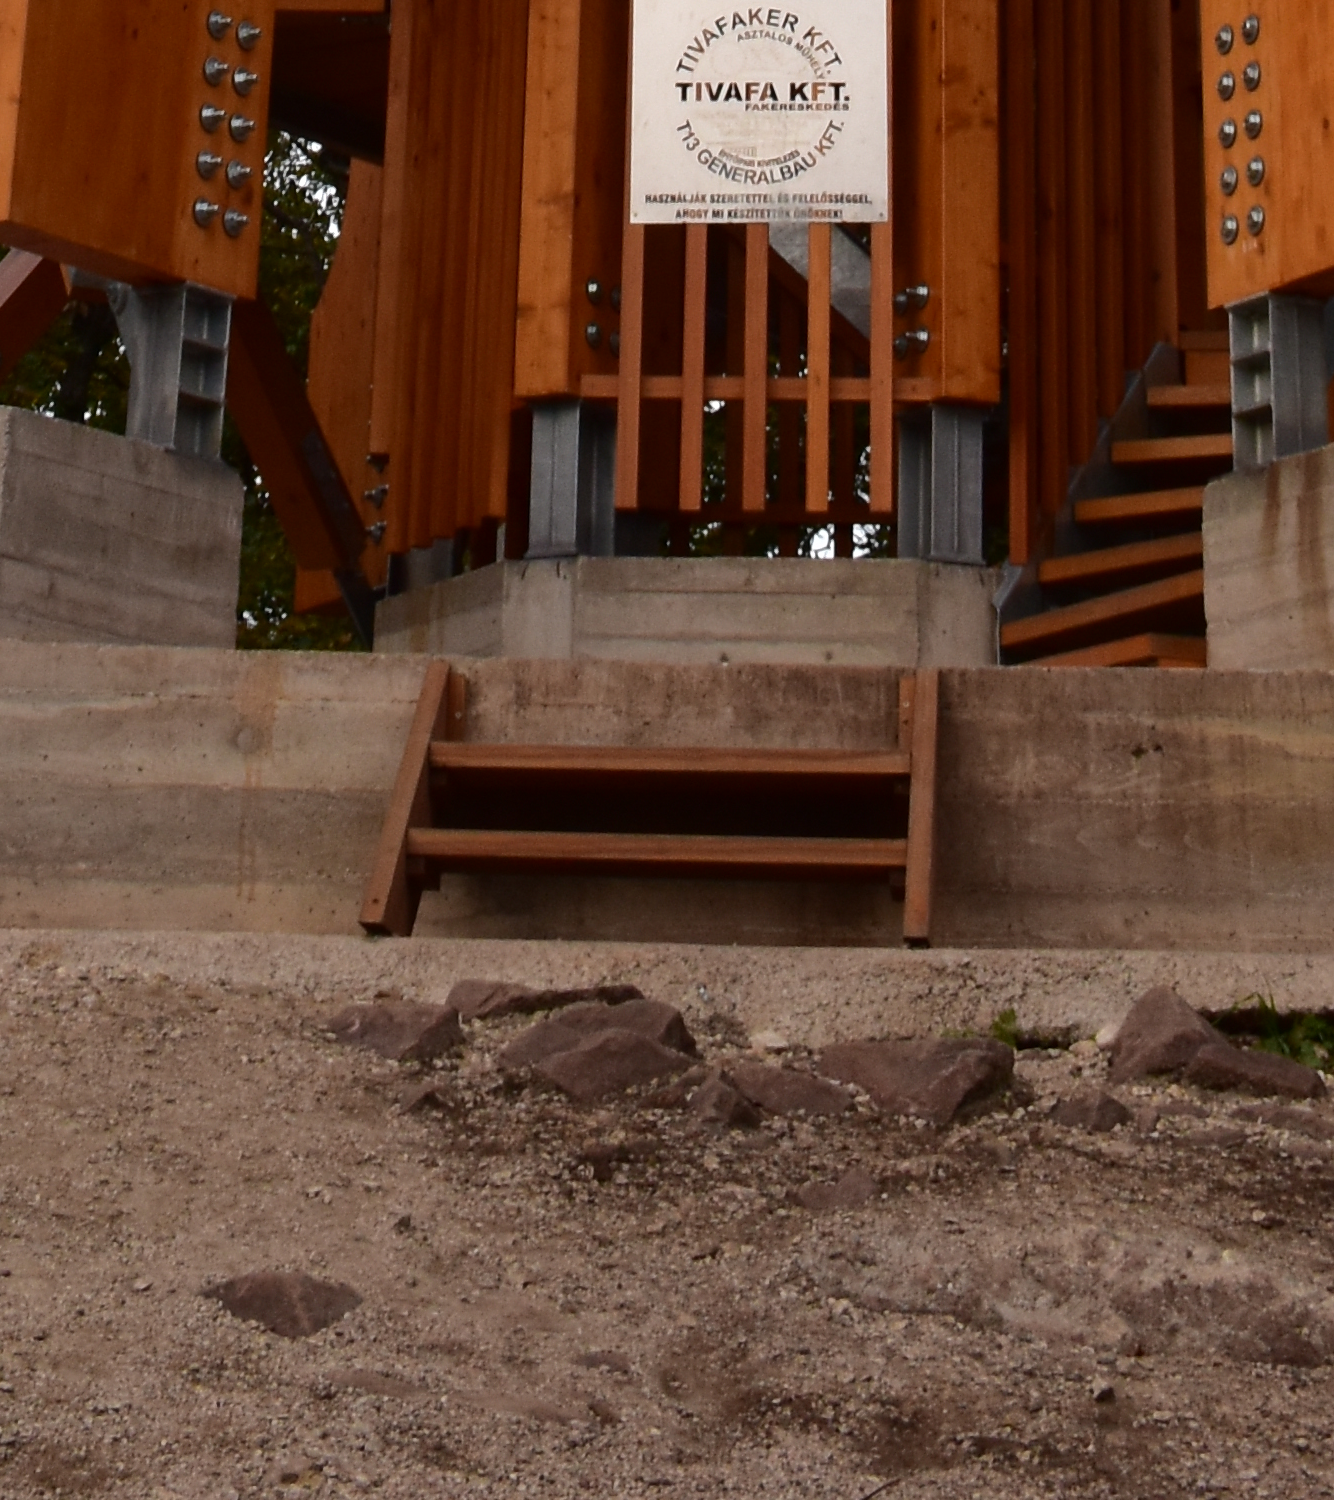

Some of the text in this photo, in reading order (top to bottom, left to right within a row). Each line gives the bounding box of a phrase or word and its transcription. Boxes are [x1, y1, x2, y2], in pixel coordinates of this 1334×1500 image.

[675, 7, 843, 75] TIVAFAKER KFT.
[736, 29, 793, 46] ASZTALOS
[675, 82, 851, 101] TIVAFA KFT.
[676, 119, 845, 185] T13 GENERALBAU KFT.
[645, 191, 707, 204] HASZNÁLJÁK
[710, 193, 773, 204] SZERETETTEL
[675, 209, 708, 219] AHOGY
[712, 209, 724, 219] MI
